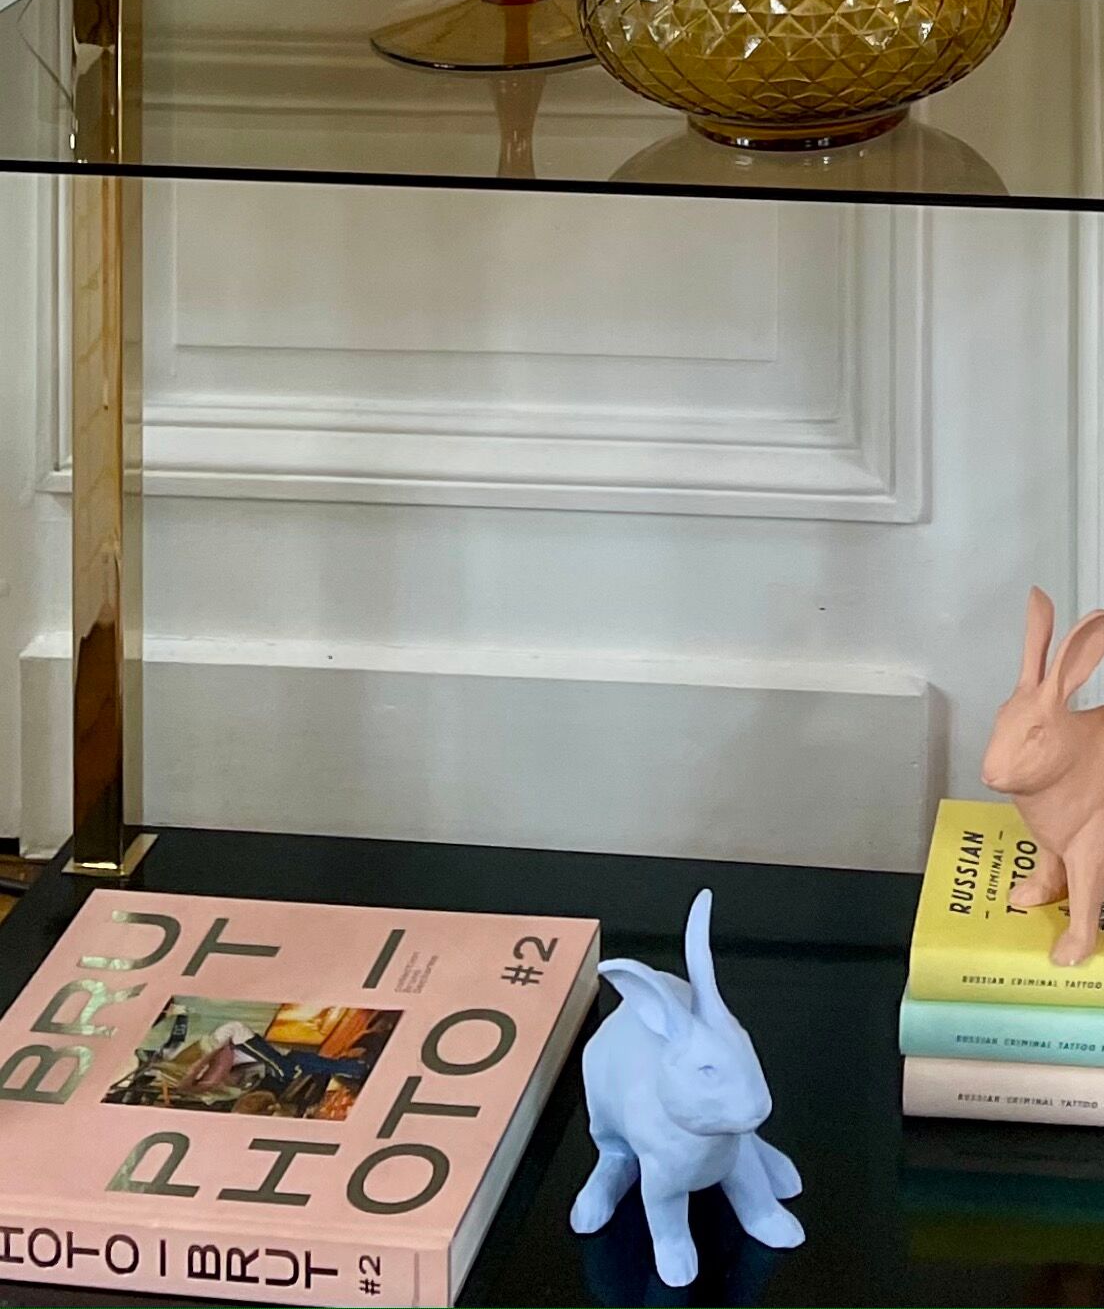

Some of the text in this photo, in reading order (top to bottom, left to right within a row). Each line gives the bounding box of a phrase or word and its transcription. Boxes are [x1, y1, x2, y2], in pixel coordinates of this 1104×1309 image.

[949, 830, 984, 915] RUSSIAN
[985, 849, 1004, 901] CRIMINAL
[1006, 840, 1038, 915] TTOO
[500, 934, 559, 986] #2
[962, 975, 1004, 984] RUSSIAN
[1011, 977, 1057, 987] CRIMINAL
[1065, 980, 1102, 989] TATTOO
[956, 1035, 998, 1045] RUSSIAN
[1004, 1038, 1050, 1048] CRIMINAL
[1058, 1041, 1096, 1051] TATTOO
[958, 1093, 1000, 1103] RUSSIAN
[1006, 1096, 1053, 1106] CRIMINAL
[1060, 1099, 1098, 1109] TATTOO
[0, 1225, 140, 1275] HOTO
[187, 1244, 339, 1289] BRUT
[358, 1254, 382, 1296] #2
